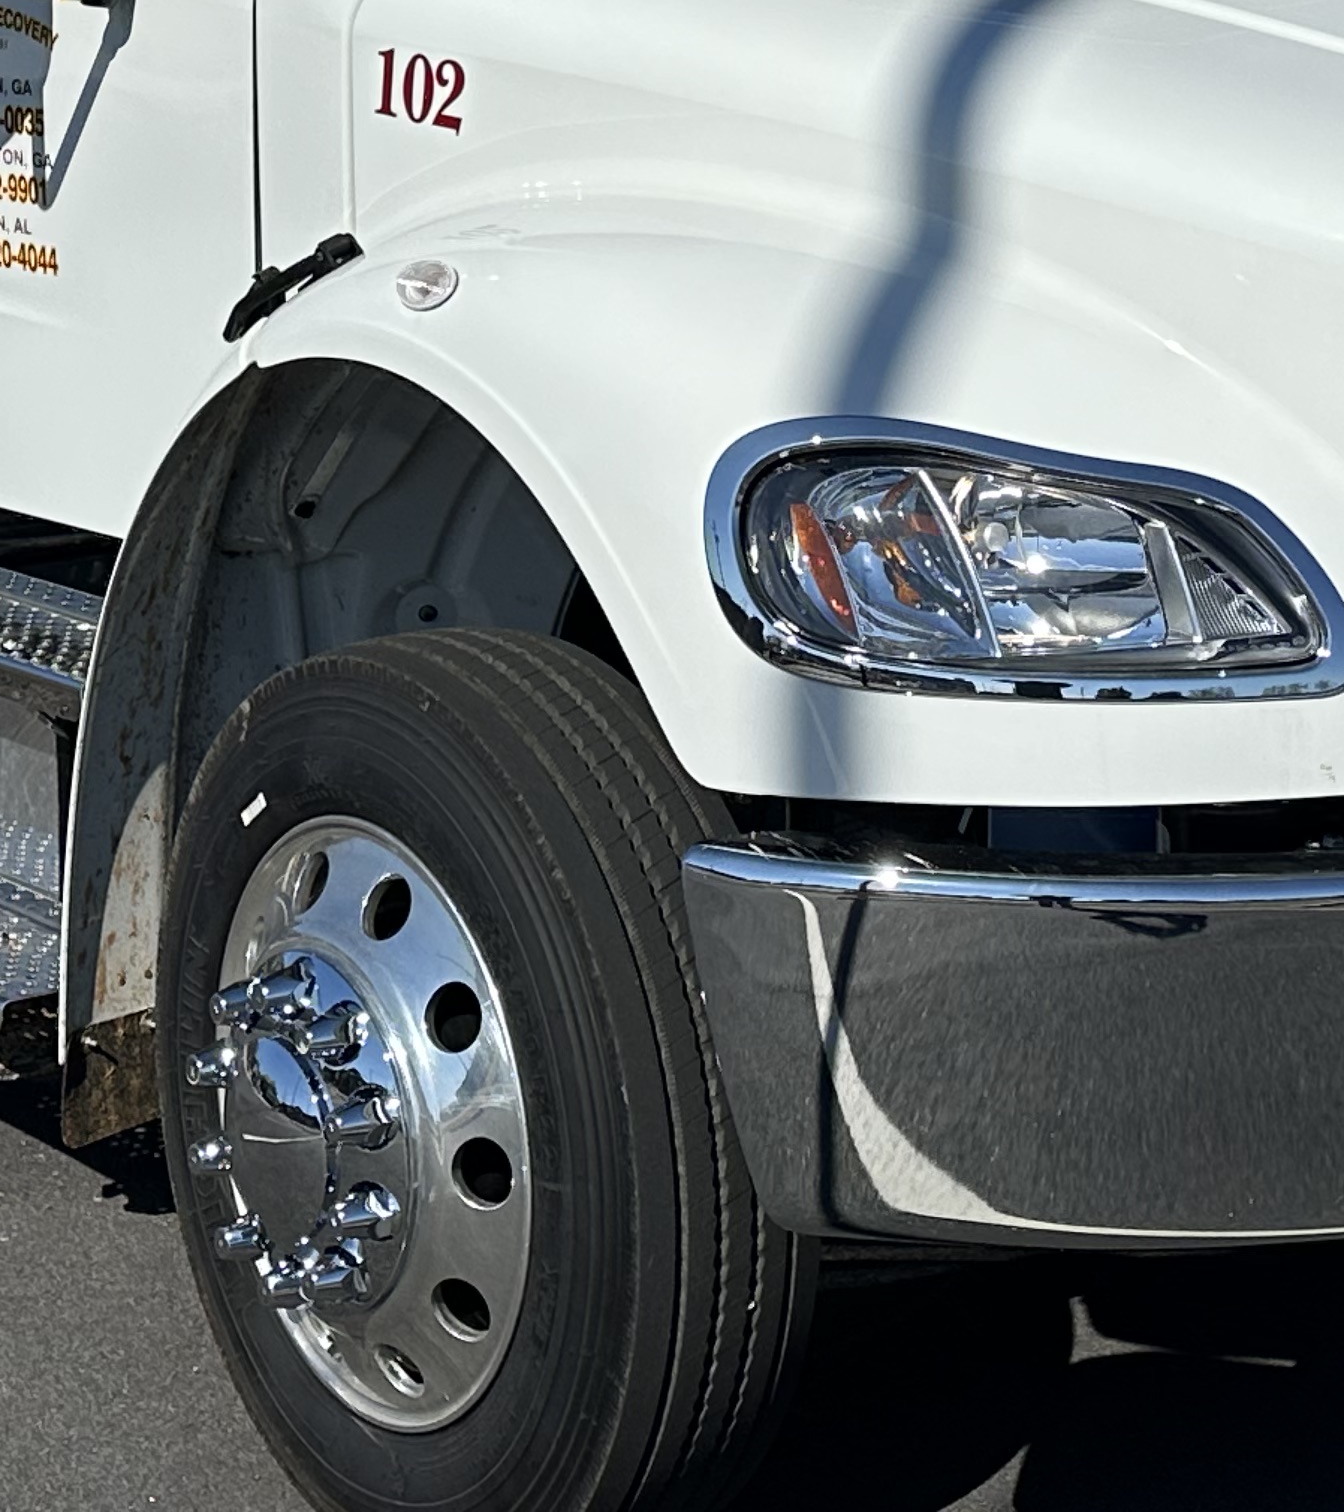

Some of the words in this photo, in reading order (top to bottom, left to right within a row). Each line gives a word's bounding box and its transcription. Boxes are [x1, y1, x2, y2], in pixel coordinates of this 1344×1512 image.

[11, 79, 32, 96] GA
[375, 48, 465, 136] 102
[32, 152, 54, 169] GA
[14, 217, 32, 235] AL
